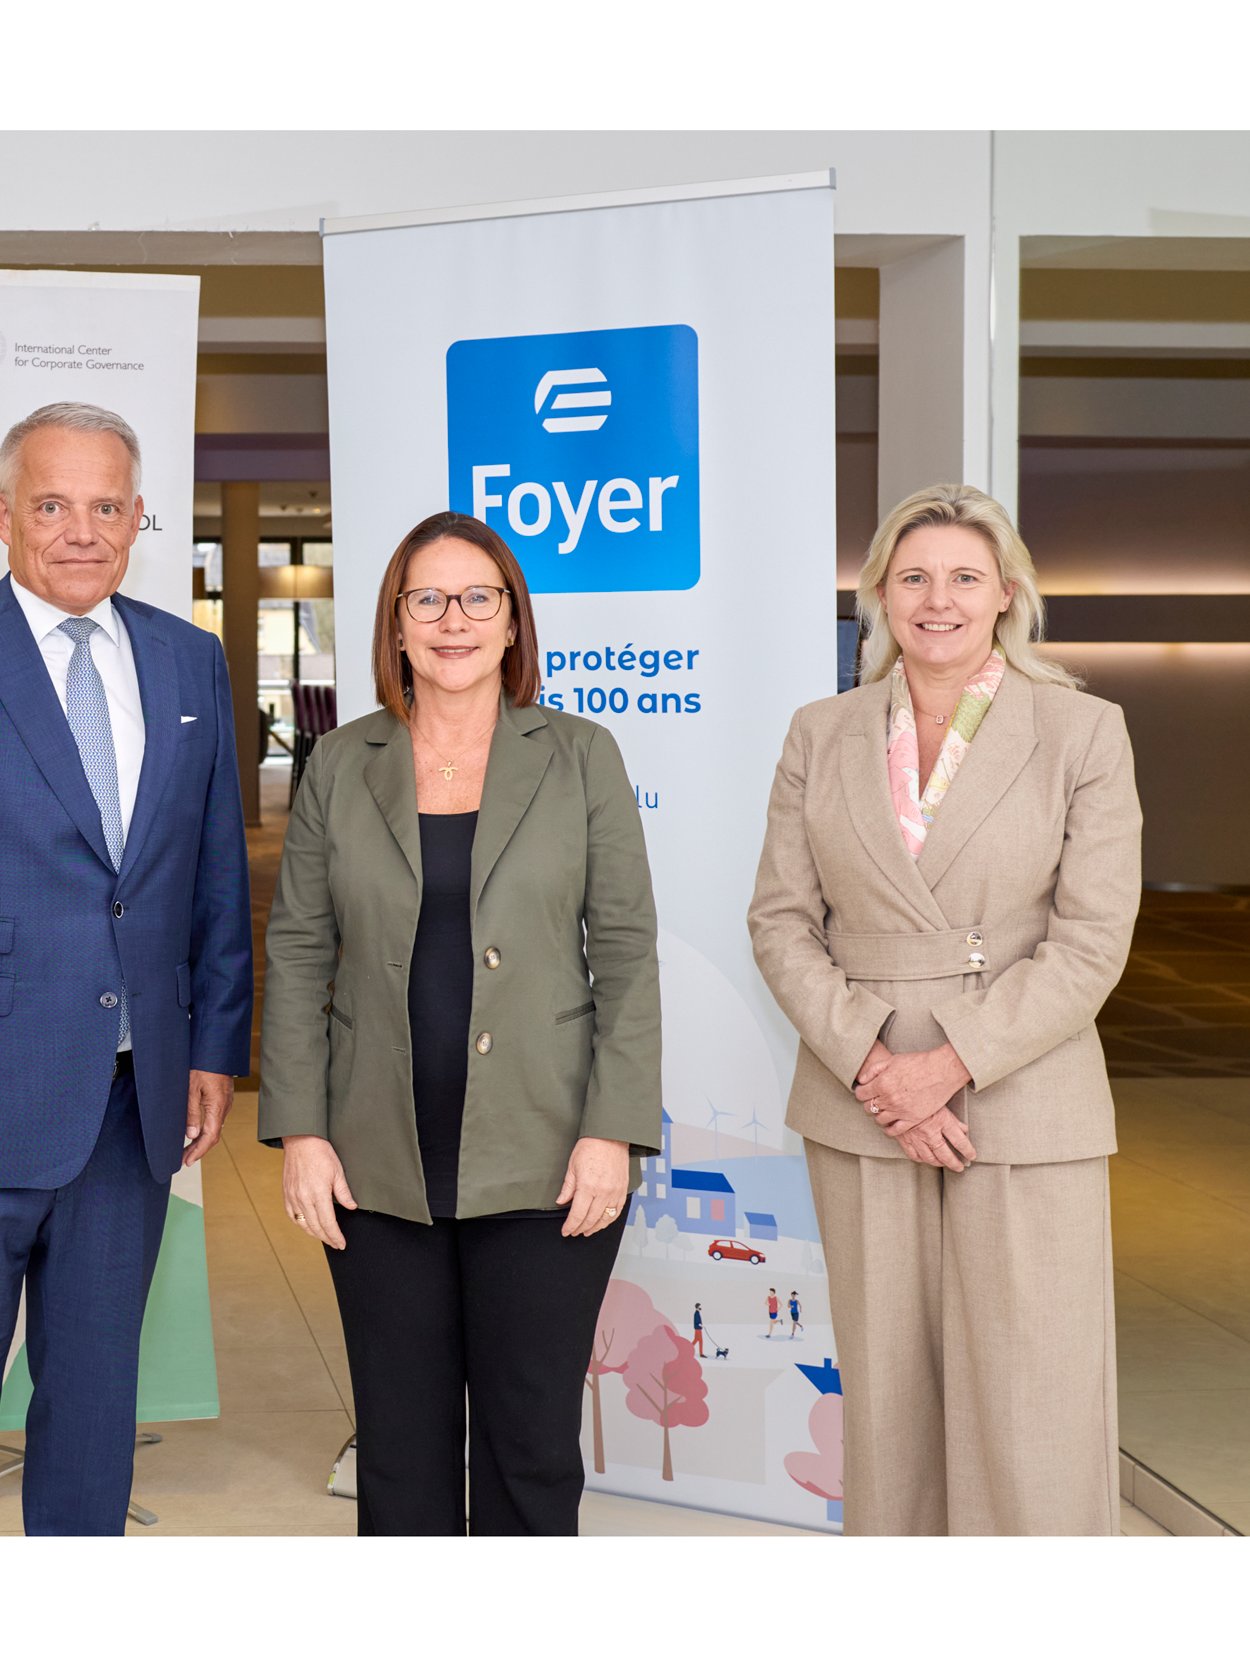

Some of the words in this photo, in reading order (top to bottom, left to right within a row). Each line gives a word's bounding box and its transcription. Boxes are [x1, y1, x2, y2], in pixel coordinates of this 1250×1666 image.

[14, 342, 75, 355] International
[77, 344, 113, 356] Center
[14, 357, 30, 367] for
[31, 357, 83, 371] Corporate
[85, 359, 145, 371] Governance
[471, 462, 680, 556] Foyer
[546, 642, 700, 678] protéger
[573, 687, 629, 714] 100
[637, 692, 702, 714] ans
